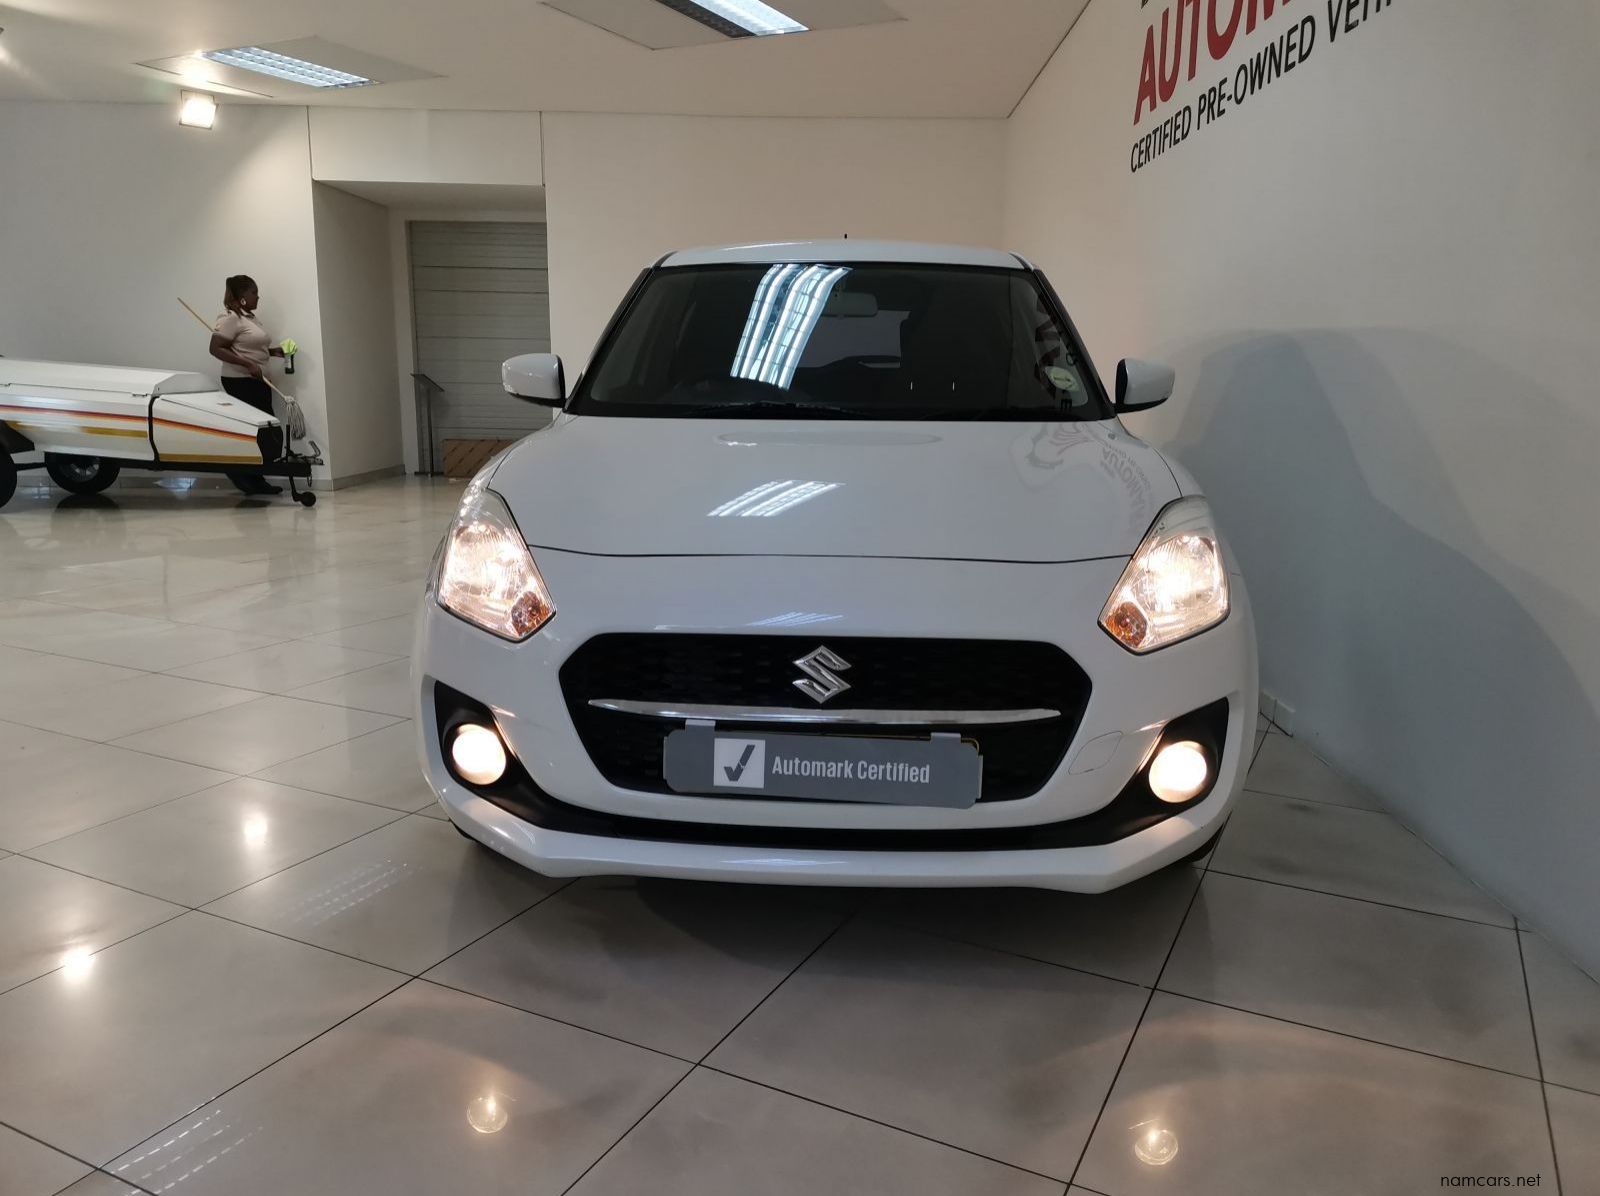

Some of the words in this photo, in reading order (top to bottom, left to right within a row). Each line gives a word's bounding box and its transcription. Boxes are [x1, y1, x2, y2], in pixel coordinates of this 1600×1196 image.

[1130, 105, 1192, 173] CERTIFIED
[1196, 15, 1316, 130] PRE-OWNED
[771, 755, 854, 779] Automark
[857, 760, 931, 784] Certified
